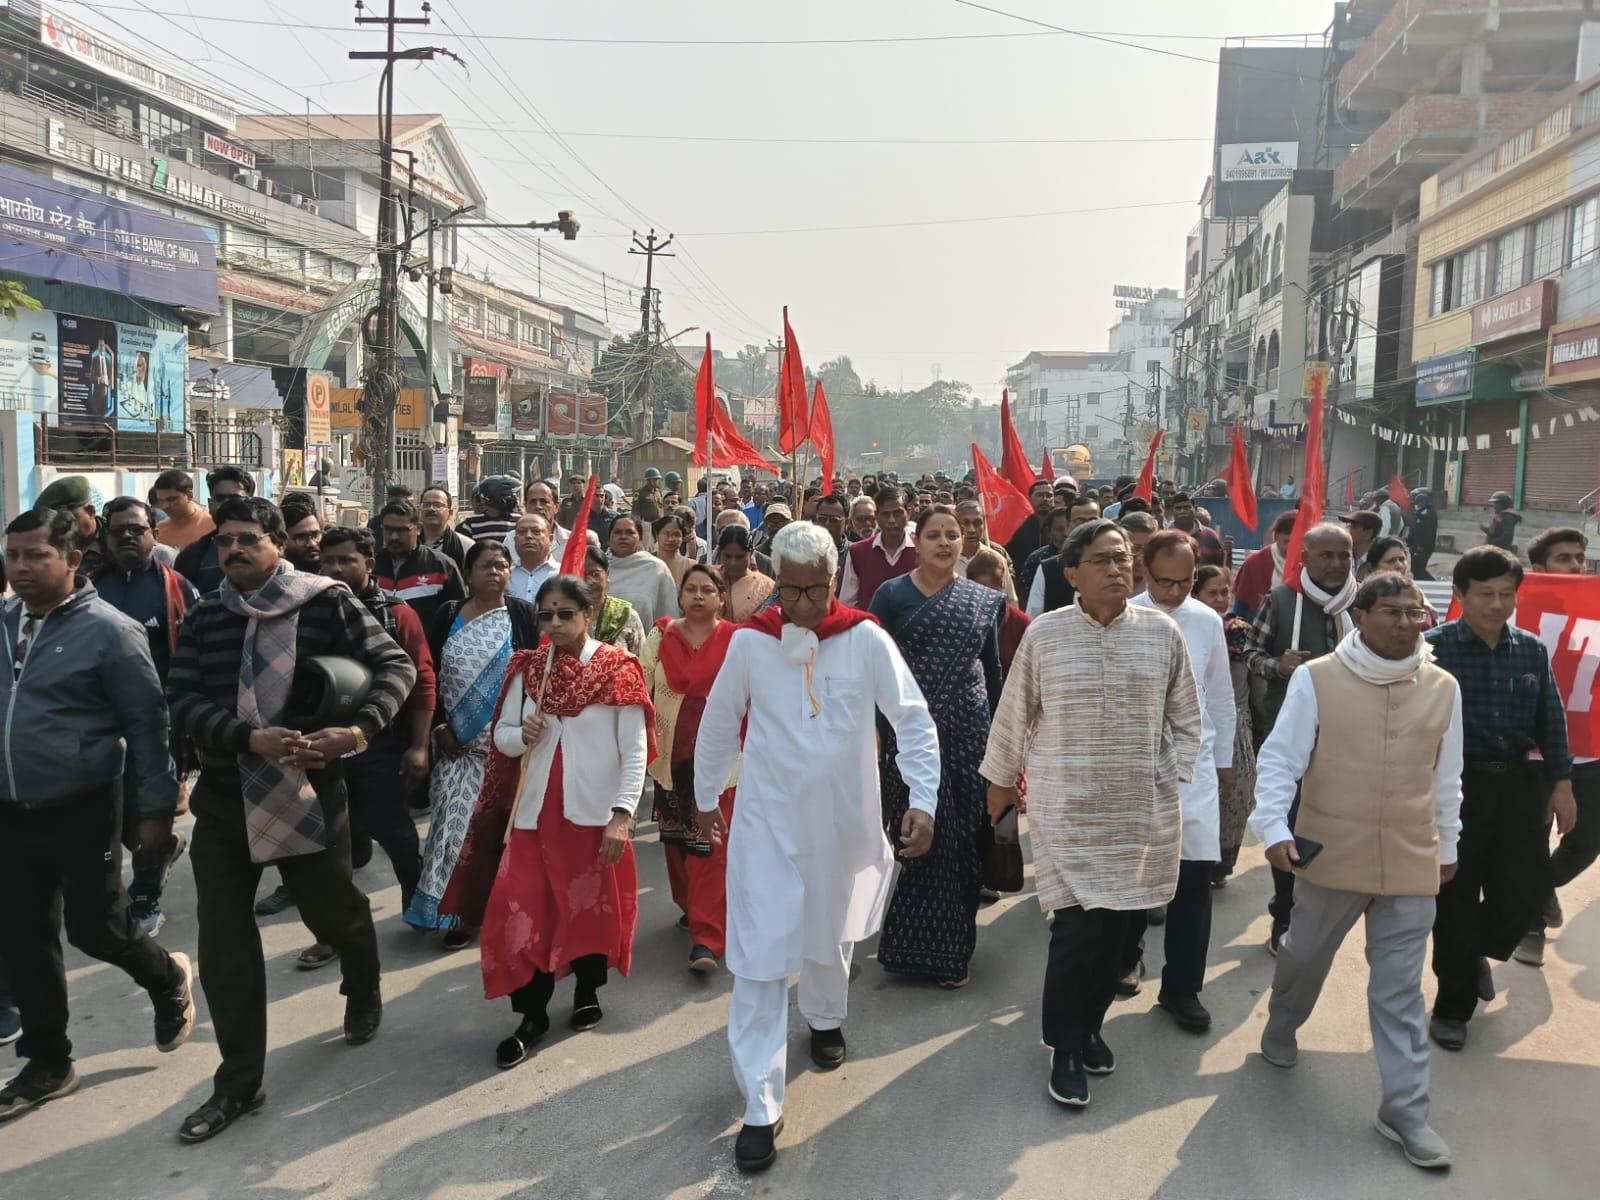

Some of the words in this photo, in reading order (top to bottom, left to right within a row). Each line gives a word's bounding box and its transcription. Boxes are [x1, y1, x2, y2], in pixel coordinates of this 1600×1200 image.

[158, 73, 165, 90] &
[207, 136, 229, 157] NOW
[231, 147, 254, 166] OPEN
[0, 196, 45, 223] भारतीय
[114, 228, 141, 250] STATE
[142, 238, 166, 257] BANK
[167, 243, 178, 258] OF
[179, 246, 200, 265] INDIA
[1492, 297, 1532, 323] HAVELLS
[1553, 337, 1598, 364] HIMALAYA
[315, 384, 323, 401] P
